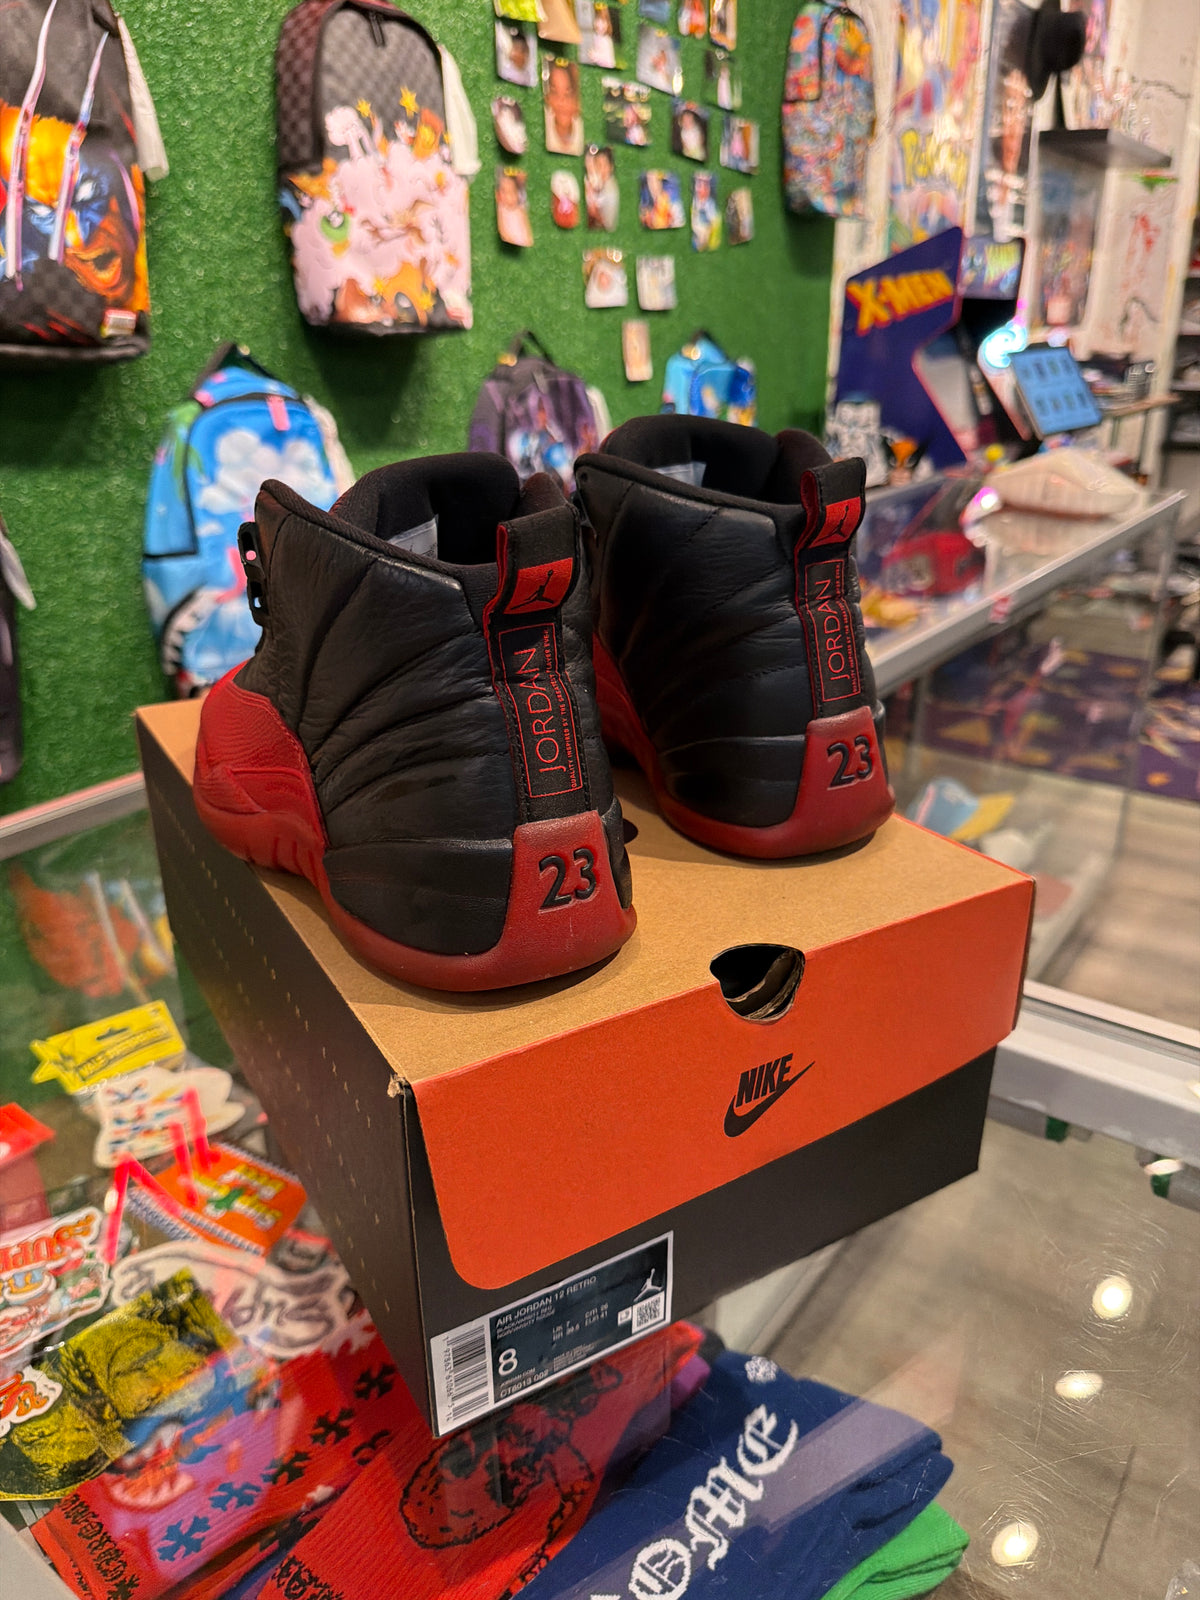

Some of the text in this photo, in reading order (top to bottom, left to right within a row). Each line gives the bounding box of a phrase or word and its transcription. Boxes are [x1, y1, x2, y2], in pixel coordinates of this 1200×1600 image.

[846, 269, 954, 337] X-MEN
[815, 579, 850, 681] JORDAN
[514, 647, 567, 774] JORDAN
[562, 718, 569, 727] BY
[563, 728, 573, 758] INSPIRED
[827, 735, 874, 789] 23
[568, 760, 577, 789] QUALITY
[538, 847, 598, 910] 23
[736, 1053, 793, 1108] NIKE
[496, 1275, 597, 1329] AIR JORDAN 12 RETRO
[498, 1348, 519, 1377] 8
[591, 1404, 799, 1600] OME
